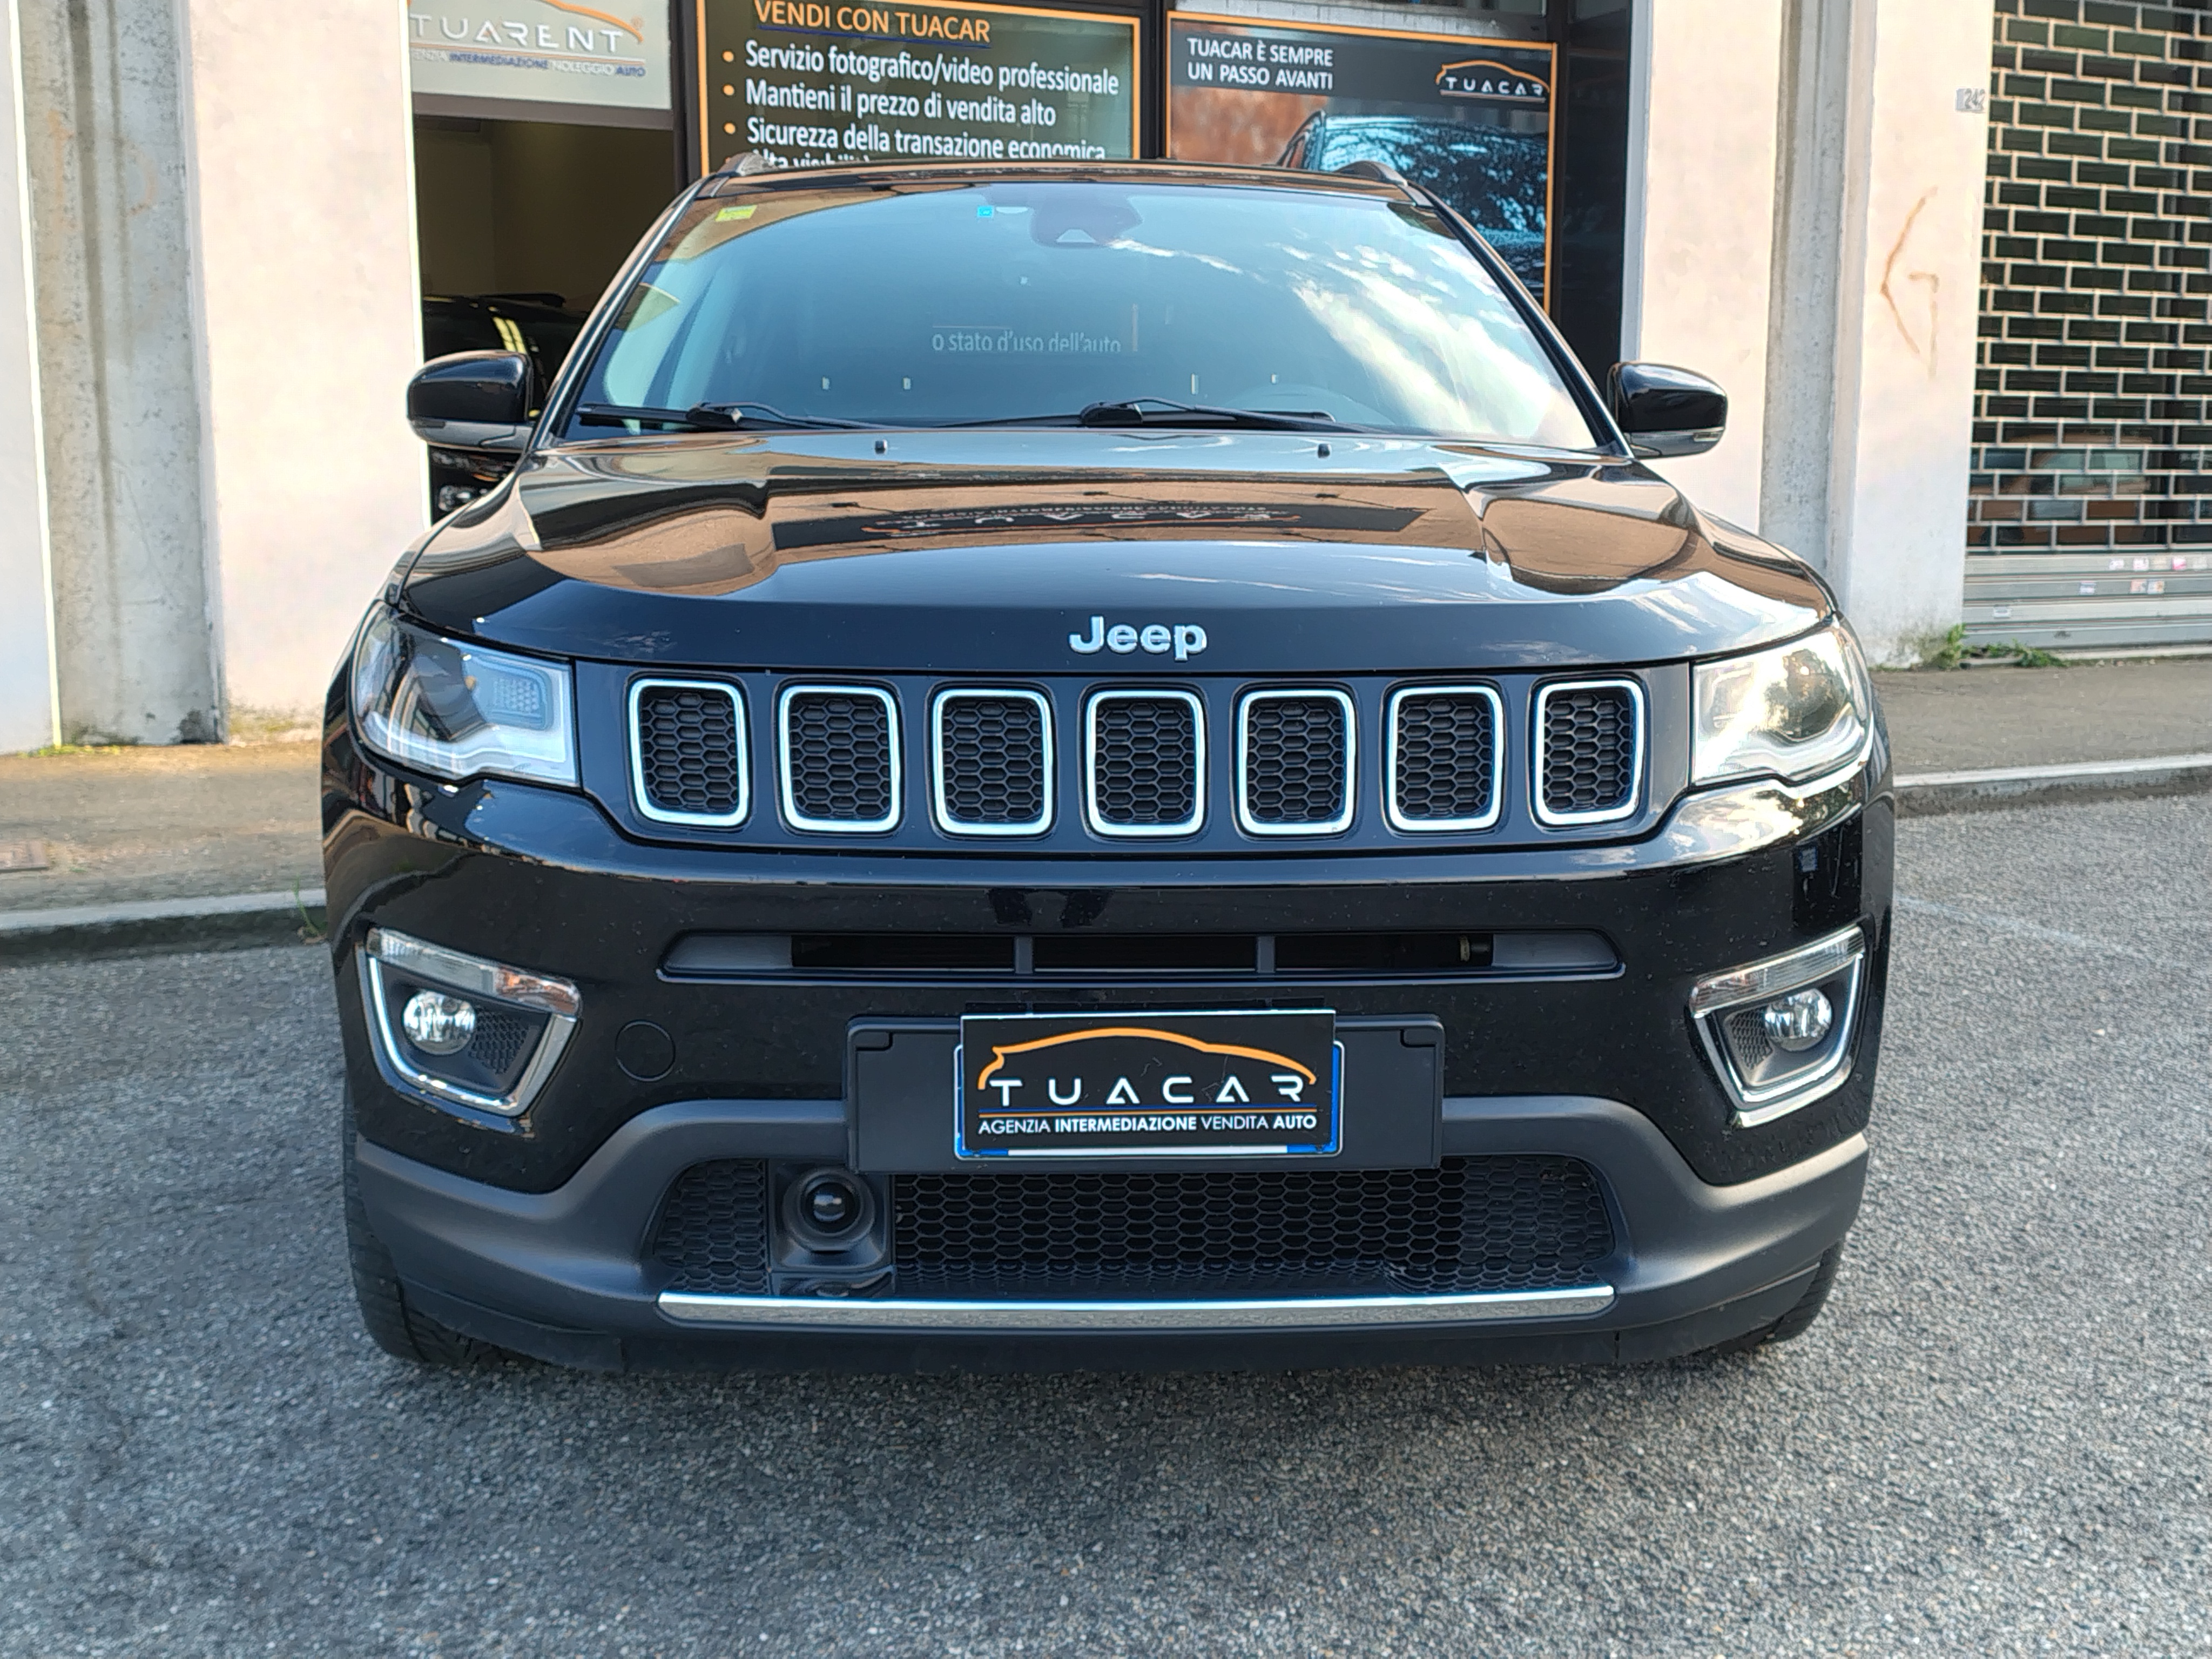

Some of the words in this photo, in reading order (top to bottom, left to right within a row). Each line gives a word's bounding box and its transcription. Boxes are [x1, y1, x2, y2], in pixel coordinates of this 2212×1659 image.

[410, 15, 624, 52] TUARENT
[754, 0, 831, 28] VENDI
[837, 7, 889, 34] CON
[894, 12, 990, 42] TUACAR
[745, 40, 824, 72] Servizio
[827, 45, 994, 85] fotografico/video
[998, 62, 1120, 95] professionale
[1187, 38, 1252, 60] TUACAR
[1257, 39, 1266, 61] È
[1270, 44, 1333, 67] SEMPRE
[616, 65, 646, 77] AUTO
[1188, 62, 1212, 80] UN
[1219, 64, 1270, 85] PASSO
[1275, 69, 1333, 90] AVANTI
[1445, 77, 1543, 96] TUACAR
[746, 79, 835, 111] Mantieni
[841, 87, 852, 112] il
[857, 92, 920, 119] prezzo
[924, 92, 942, 118] di
[947, 96, 1016, 123] vendita
[1021, 98, 1056, 126] alto
[747, 117, 838, 149] Sicurezza
[843, 123, 890, 152] della
[894, 129, 1004, 158] transazione
[1008, 140, 1105, 160] economica
[949, 332, 993, 352] stato
[997, 330, 1044, 352] d'uso
[1048, 332, 1122, 353] dell'auto
[1069, 616, 1208, 662] Jeep
[989, 1075, 1305, 1106] TUACAR
[979, 1120, 1051, 1134] AGENZIA
[1055, 1117, 1197, 1133] INTERMEDIAZIONE
[1201, 1116, 1269, 1130] VENDITA
[1273, 1115, 1318, 1130] AUTO
